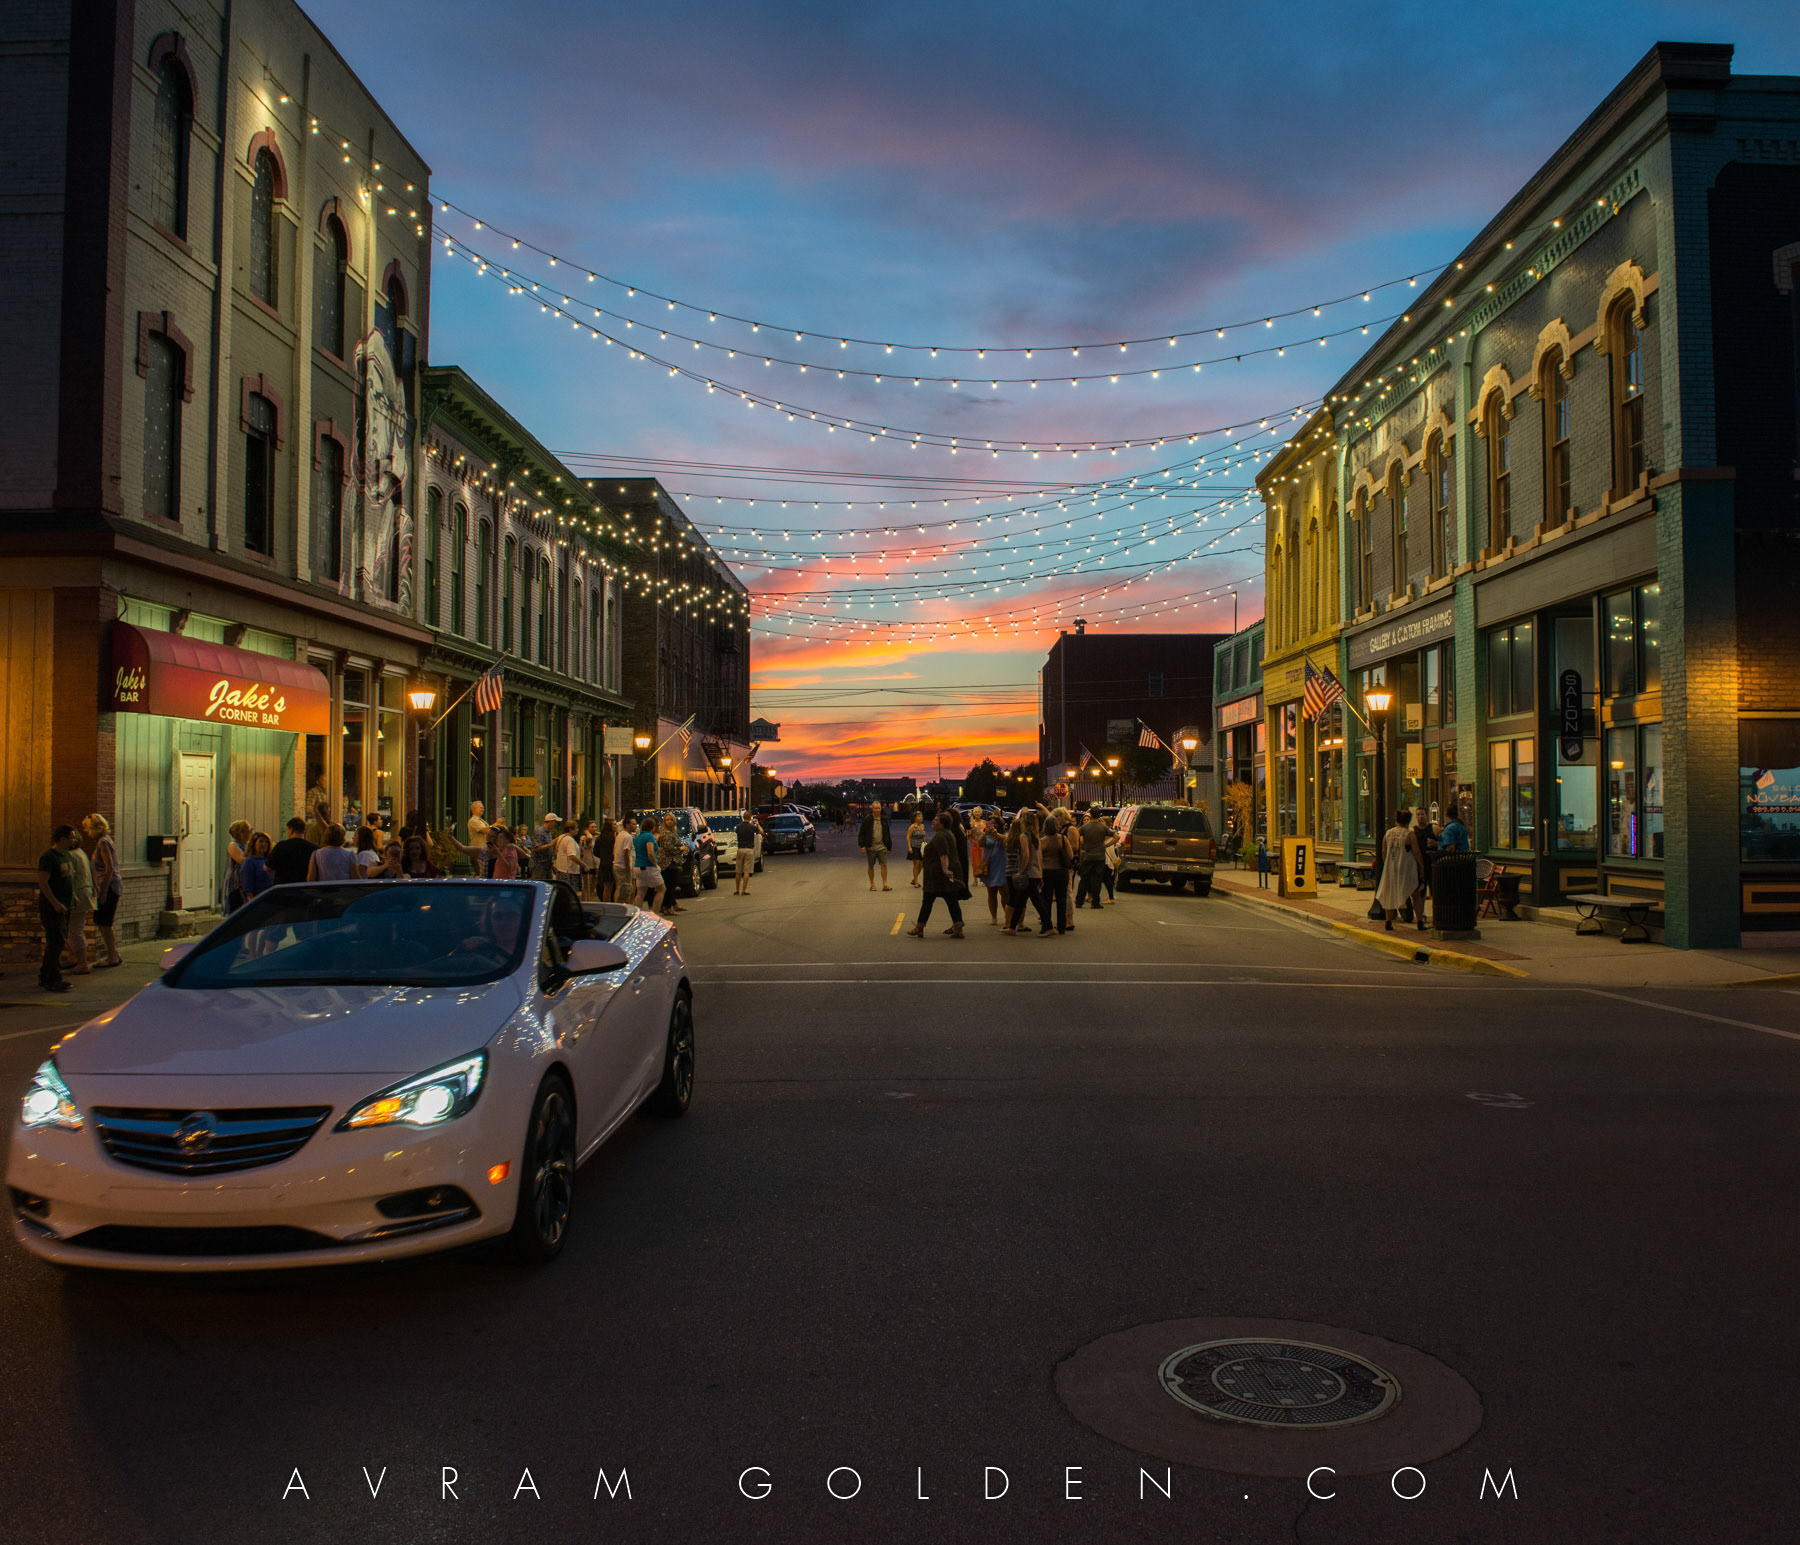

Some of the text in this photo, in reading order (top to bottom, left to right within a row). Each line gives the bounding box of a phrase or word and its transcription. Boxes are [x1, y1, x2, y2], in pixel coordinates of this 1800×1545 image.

[1369, 631, 1391, 654] GALLERY
[1392, 630, 1397, 646] &
[1397, 621, 1422, 644] CUSTOM
[1422, 608, 1453, 636] FRAMING
[114, 666, 146, 698] Jake's
[120, 691, 139, 702] BAR
[204, 680, 287, 717] Jake's
[219, 707, 280, 726] CORNER BAR
[1564, 674, 1579, 733] SALON
